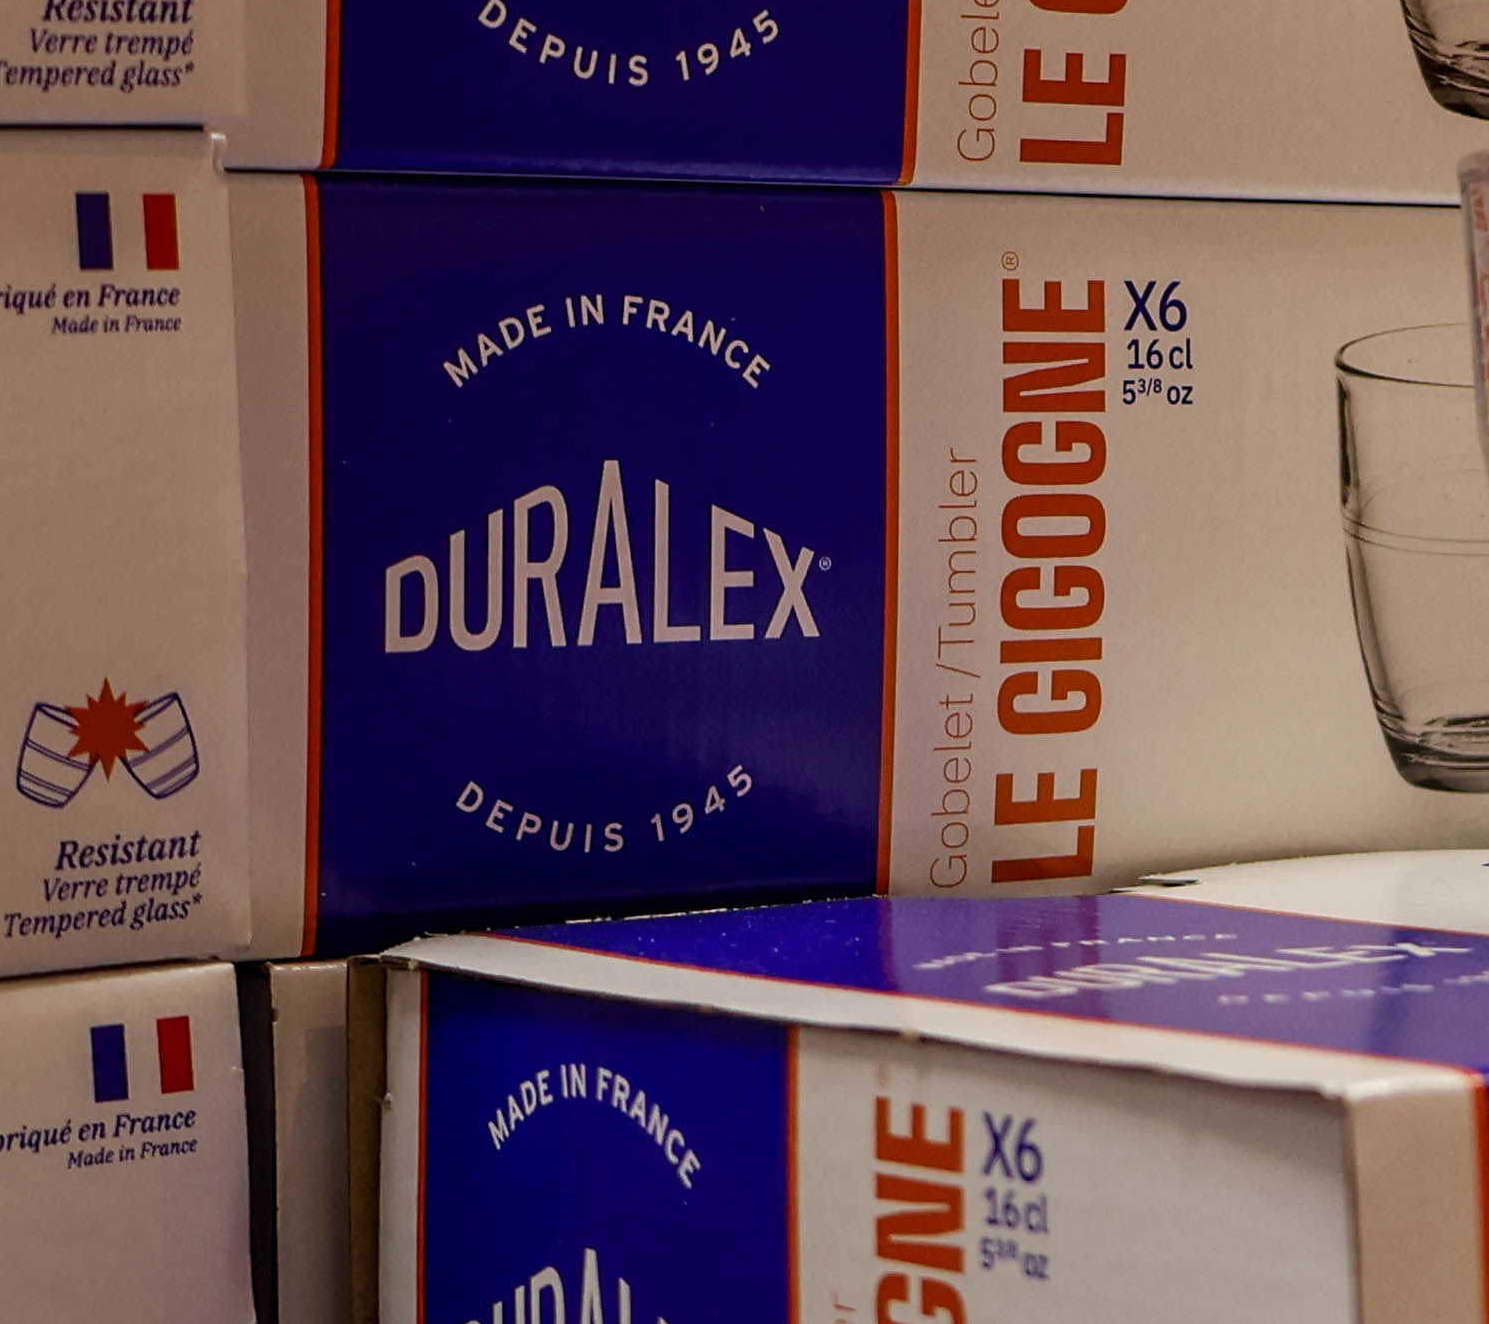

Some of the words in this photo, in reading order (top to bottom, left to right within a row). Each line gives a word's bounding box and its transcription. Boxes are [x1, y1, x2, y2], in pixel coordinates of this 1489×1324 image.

[30, 28, 97, 55] Verre
[105, 29, 194, 61] trempé
[675, 8, 780, 81] 1945
[1020, 48, 1127, 166] LE
[63, 289, 90, 307] en
[98, 284, 180, 307] France
[1124, 280, 1187, 332] X6
[52, 317, 98, 335] Made
[103, 317, 119, 333] in
[124, 315, 181, 333] France
[443, 304, 552, 388] MADE
[565, 293, 605, 328] IN
[622, 295, 771, 389] FRANCE
[456, 780, 624, 853] DEPUIS
[650, 763, 754, 843] 1945
[991, 767, 1098, 883] LE
[55, 830, 201, 871] Resistant
[43, 877, 108, 903] Verre
[116, 862, 201, 896] trempé
[4, 902, 126, 938] Tempered
[79, 1122, 106, 1142] en
[114, 1109, 196, 1137] France
[487, 1069, 554, 1151] MADE
[560, 1063, 587, 1099] IN
[596, 1067, 701, 1189] FRANCE
[982, 1111, 1043, 1182] X6
[67, 1149, 114, 1169] Made
[119, 1146, 135, 1161] in
[140, 1139, 198, 1159] France
